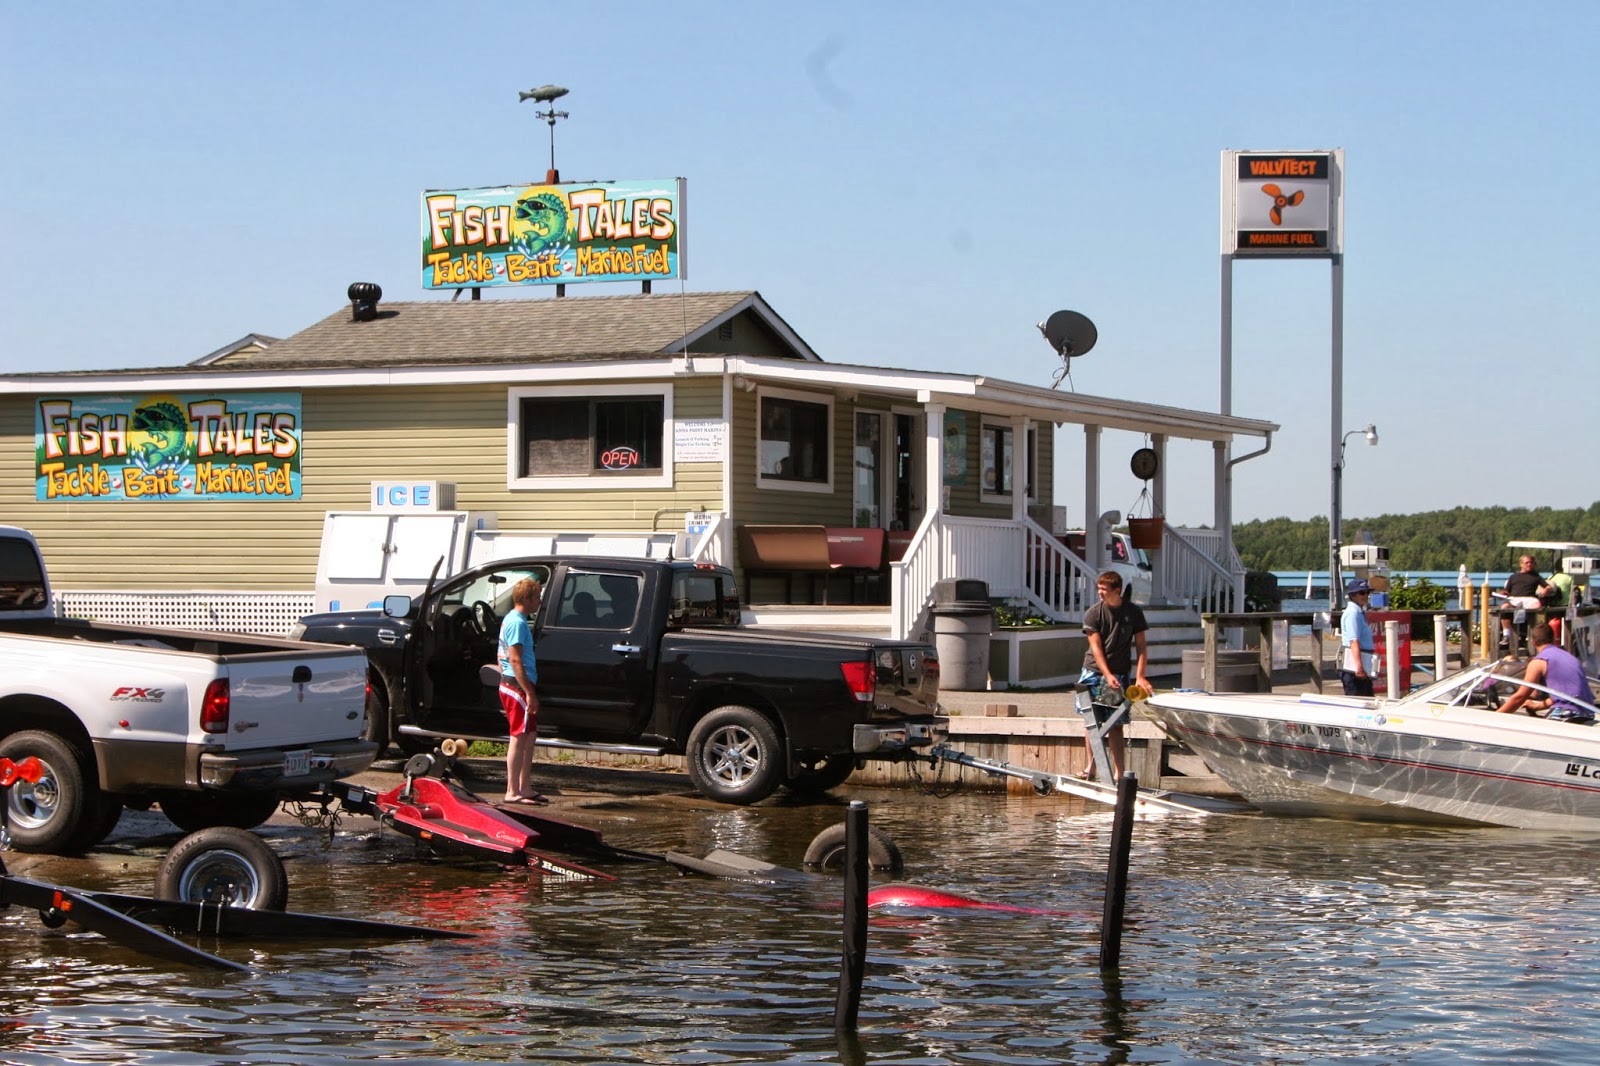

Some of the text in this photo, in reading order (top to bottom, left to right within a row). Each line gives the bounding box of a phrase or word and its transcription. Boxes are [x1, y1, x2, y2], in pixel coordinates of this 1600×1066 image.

[1249, 157, 1317, 175] VALVTECT
[426, 188, 676, 250] FISH TALES
[1249, 233, 1315, 244] MARINE FUEL
[427, 250, 494, 286] Tackle
[505, 253, 561, 282] Bait
[40, 400, 298, 459] FISH TALES
[601, 451, 638, 466] OPEN
[41, 462, 110, 499] Tackle
[122, 467, 181, 497] Bait
[377, 486, 431, 505] ICE
[112, 687, 166, 698] FX4
